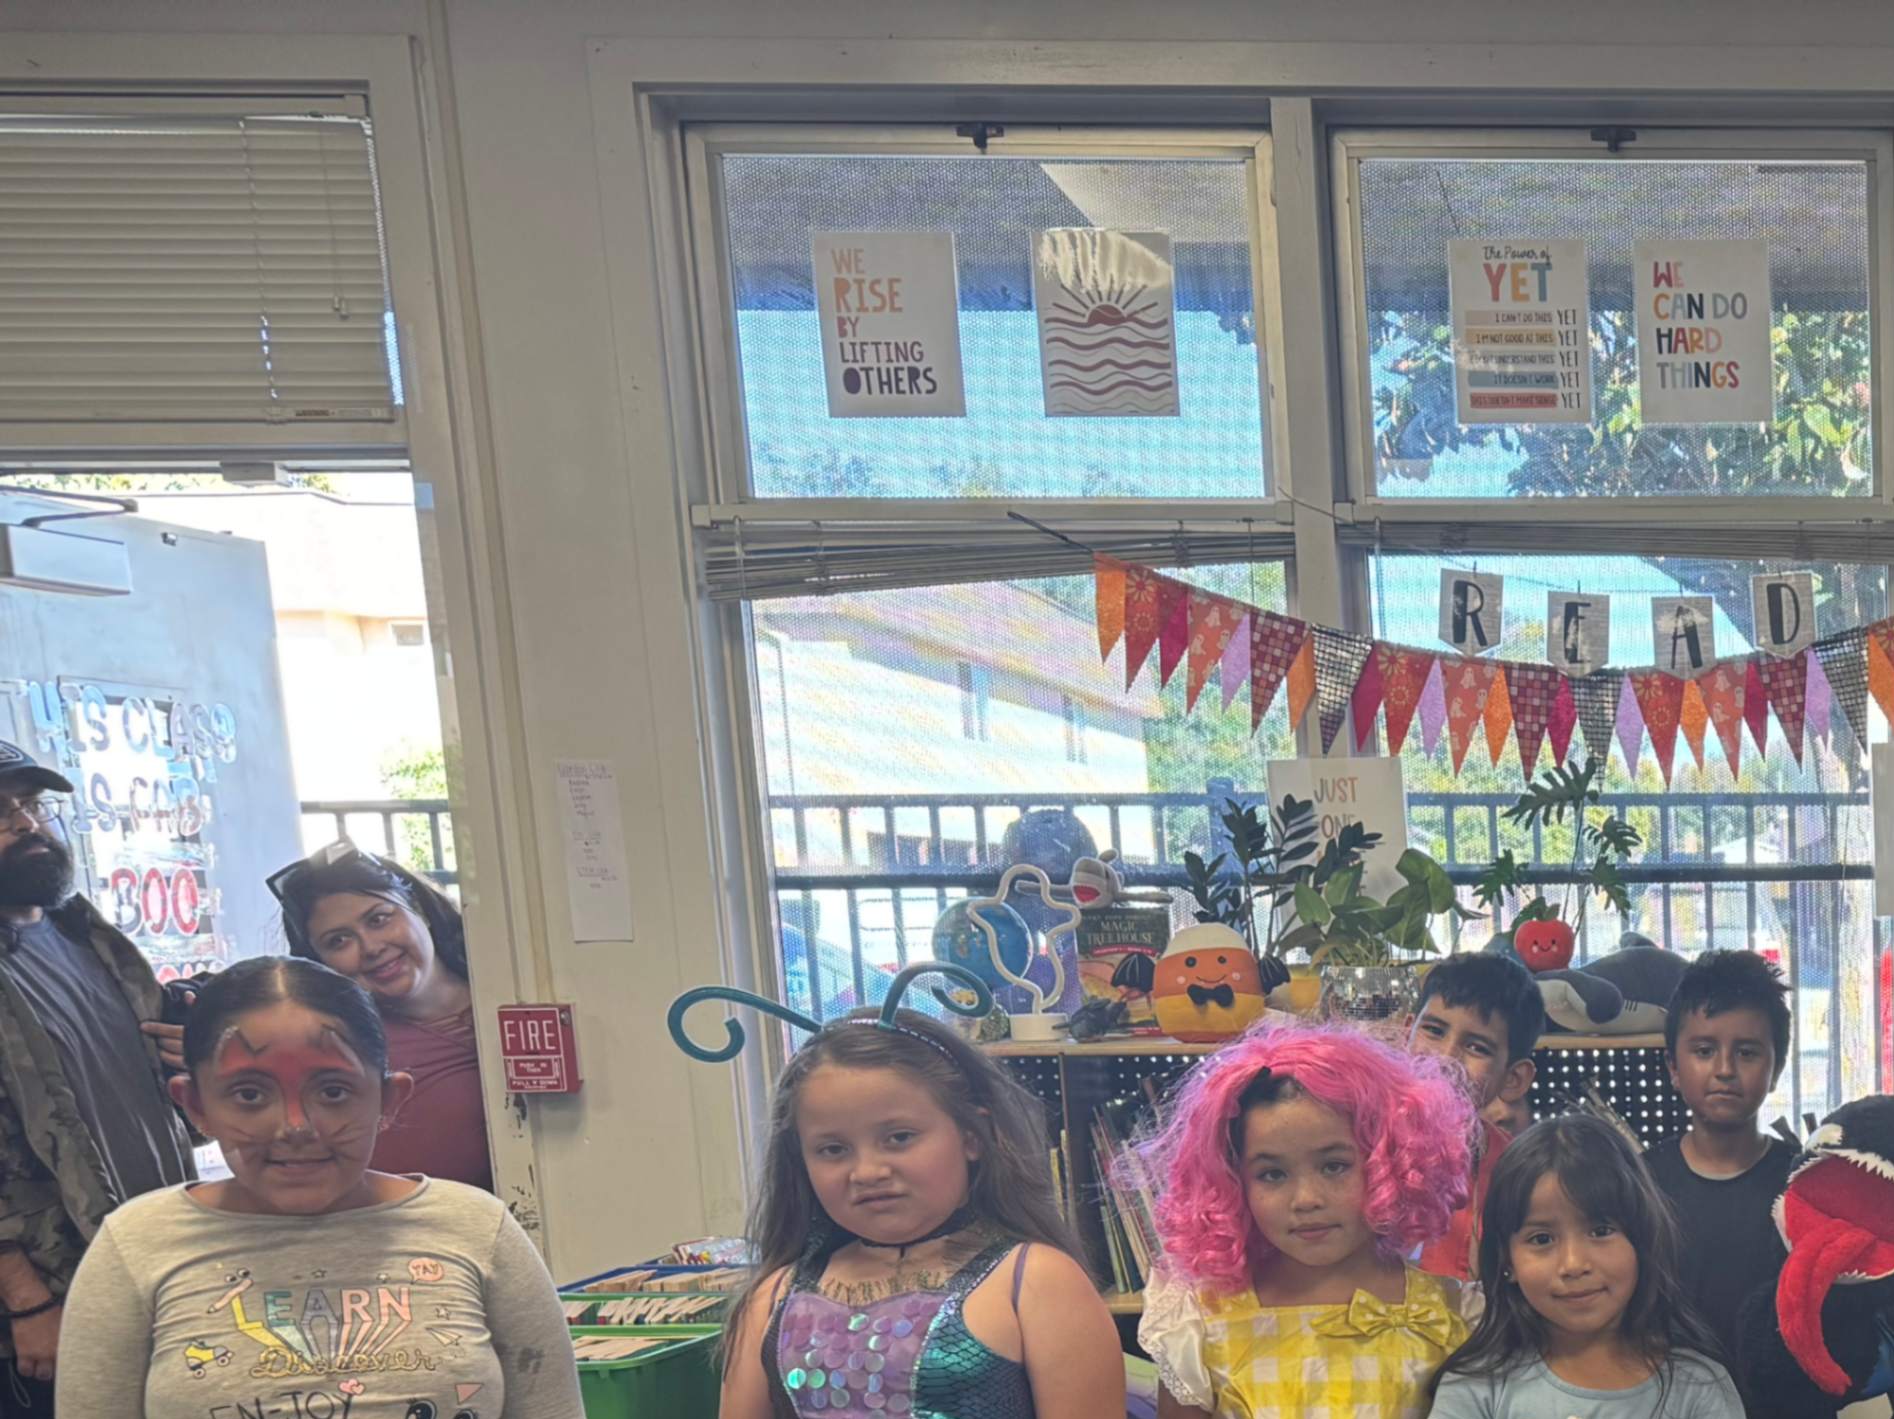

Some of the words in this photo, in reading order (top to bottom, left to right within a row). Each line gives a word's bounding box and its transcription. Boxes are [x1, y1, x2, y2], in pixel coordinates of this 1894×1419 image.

[831, 248, 865, 275] WE
[1483, 246, 1502, 260] The
[1504, 245, 1537, 260] Power
[1482, 262, 1553, 302] YET
[1653, 261, 1684, 288] WE
[833, 277, 903, 313] RISE
[1654, 293, 1704, 320] CAN
[1712, 292, 1748, 320] DO
[837, 316, 859, 339] BY
[1557, 309, 1576, 325] YET
[1558, 329, 1577, 346] YET
[1656, 327, 1723, 355] HARD
[840, 341, 924, 364] LIFTING
[1559, 351, 1578, 367] YET
[843, 366, 937, 395] OTHERS
[1560, 371, 1579, 388] YET
[1656, 361, 1740, 389] THINGS
[1561, 392, 1580, 409] YET
[1452, 579, 1801, 670] READ
[1314, 776, 1359, 803] JUST
[1321, 813, 1356, 839] ON
[504, 1020, 556, 1051] FIRE
[231, 1286, 413, 1338] LEARN
[251, 1347, 437, 1379] Discover
